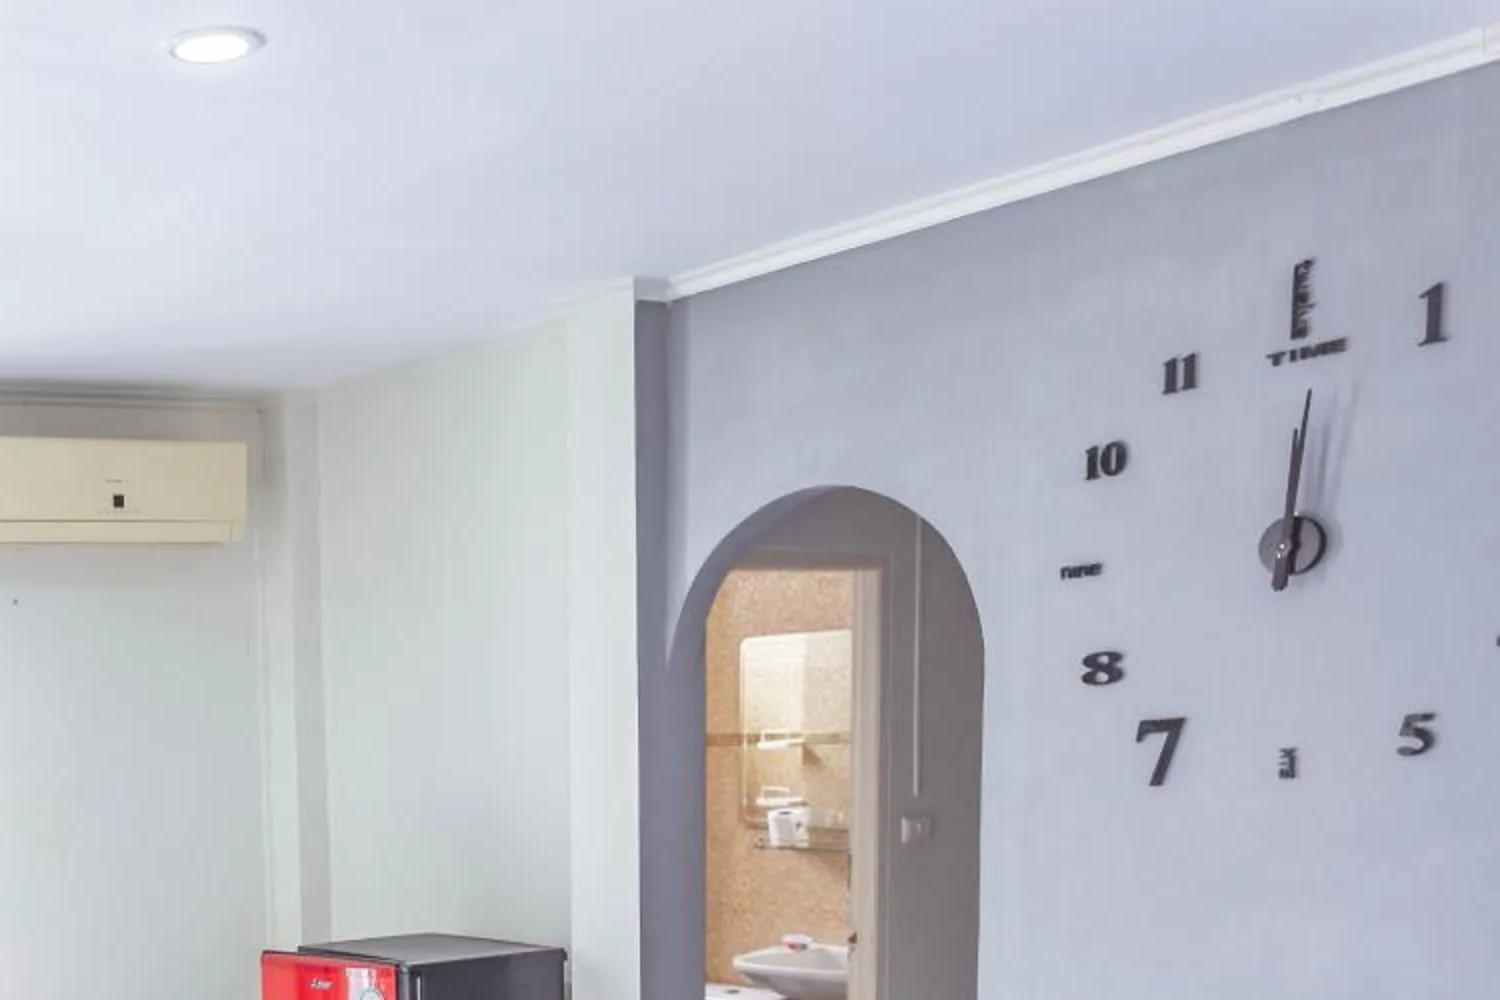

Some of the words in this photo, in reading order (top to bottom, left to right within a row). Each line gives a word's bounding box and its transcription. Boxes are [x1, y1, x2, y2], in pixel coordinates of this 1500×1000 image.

[1418, 282, 1448, 346] 1
[1266, 337, 1347, 367] TIME
[1162, 353, 1199, 395] 11
[1085, 441, 1129, 481] 10
[1081, 651, 1126, 686] 8
[1136, 716, 1187, 787] 7
[1396, 712, 1437, 757] 5
